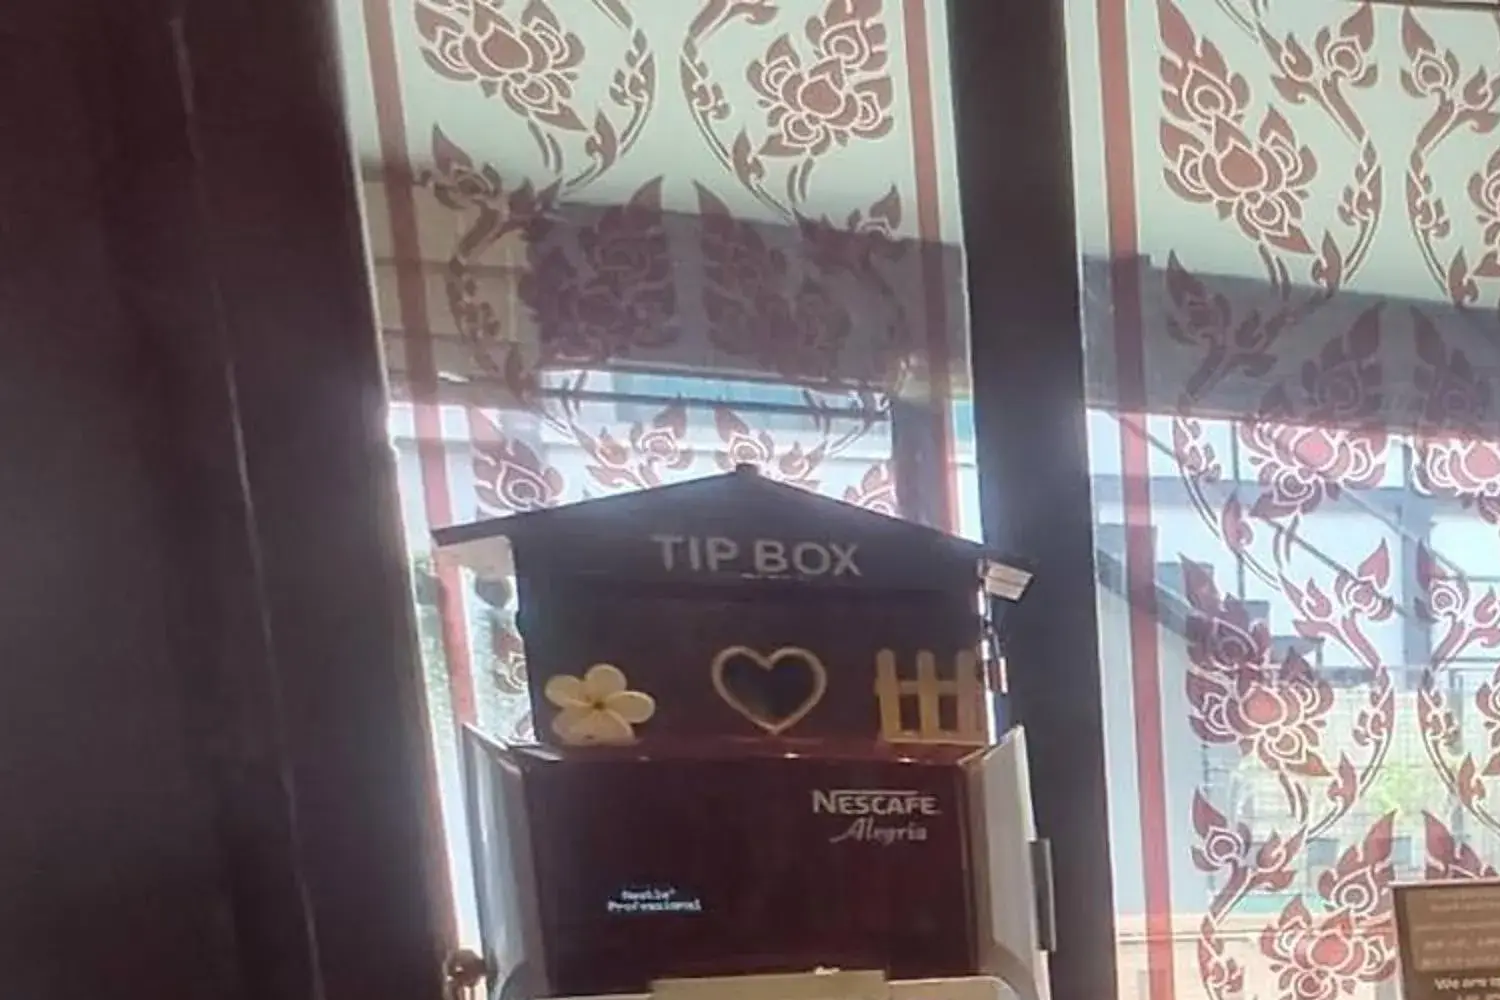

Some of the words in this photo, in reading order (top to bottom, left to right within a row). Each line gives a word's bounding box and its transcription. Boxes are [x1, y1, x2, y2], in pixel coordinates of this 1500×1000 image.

[651, 534, 739, 572] TIP
[754, 539, 863, 577] BOX
[828, 816, 928, 846] Alegria
